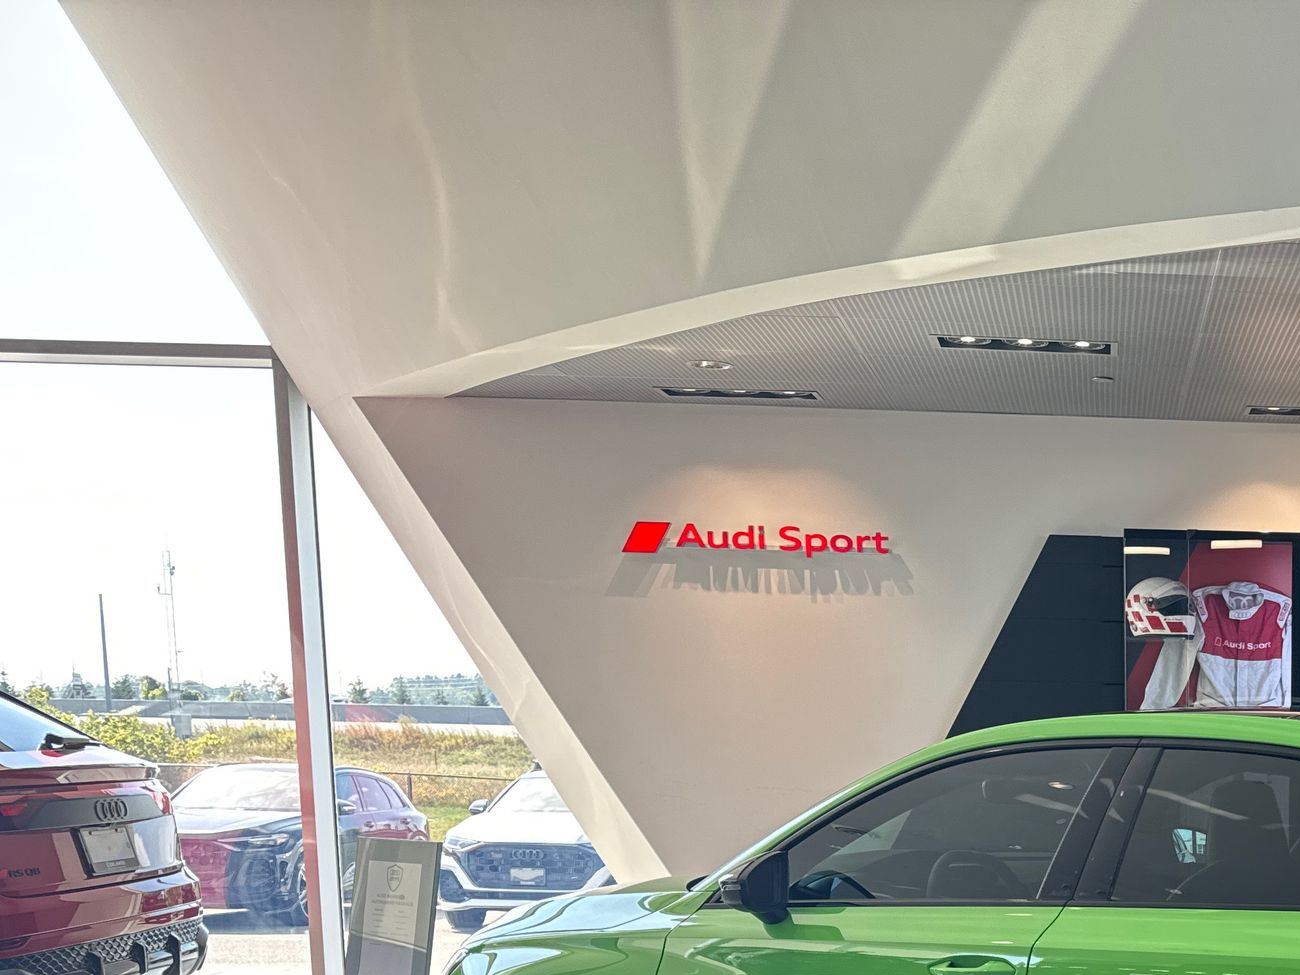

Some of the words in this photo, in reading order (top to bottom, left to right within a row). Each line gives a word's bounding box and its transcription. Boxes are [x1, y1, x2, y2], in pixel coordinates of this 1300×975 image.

[676, 523, 765, 550] Audi
[778, 525, 890, 558] Sport
[1222, 640, 1245, 649] Audi
[1247, 640, 1271, 651] Sport
[8, 869, 24, 878] RS
